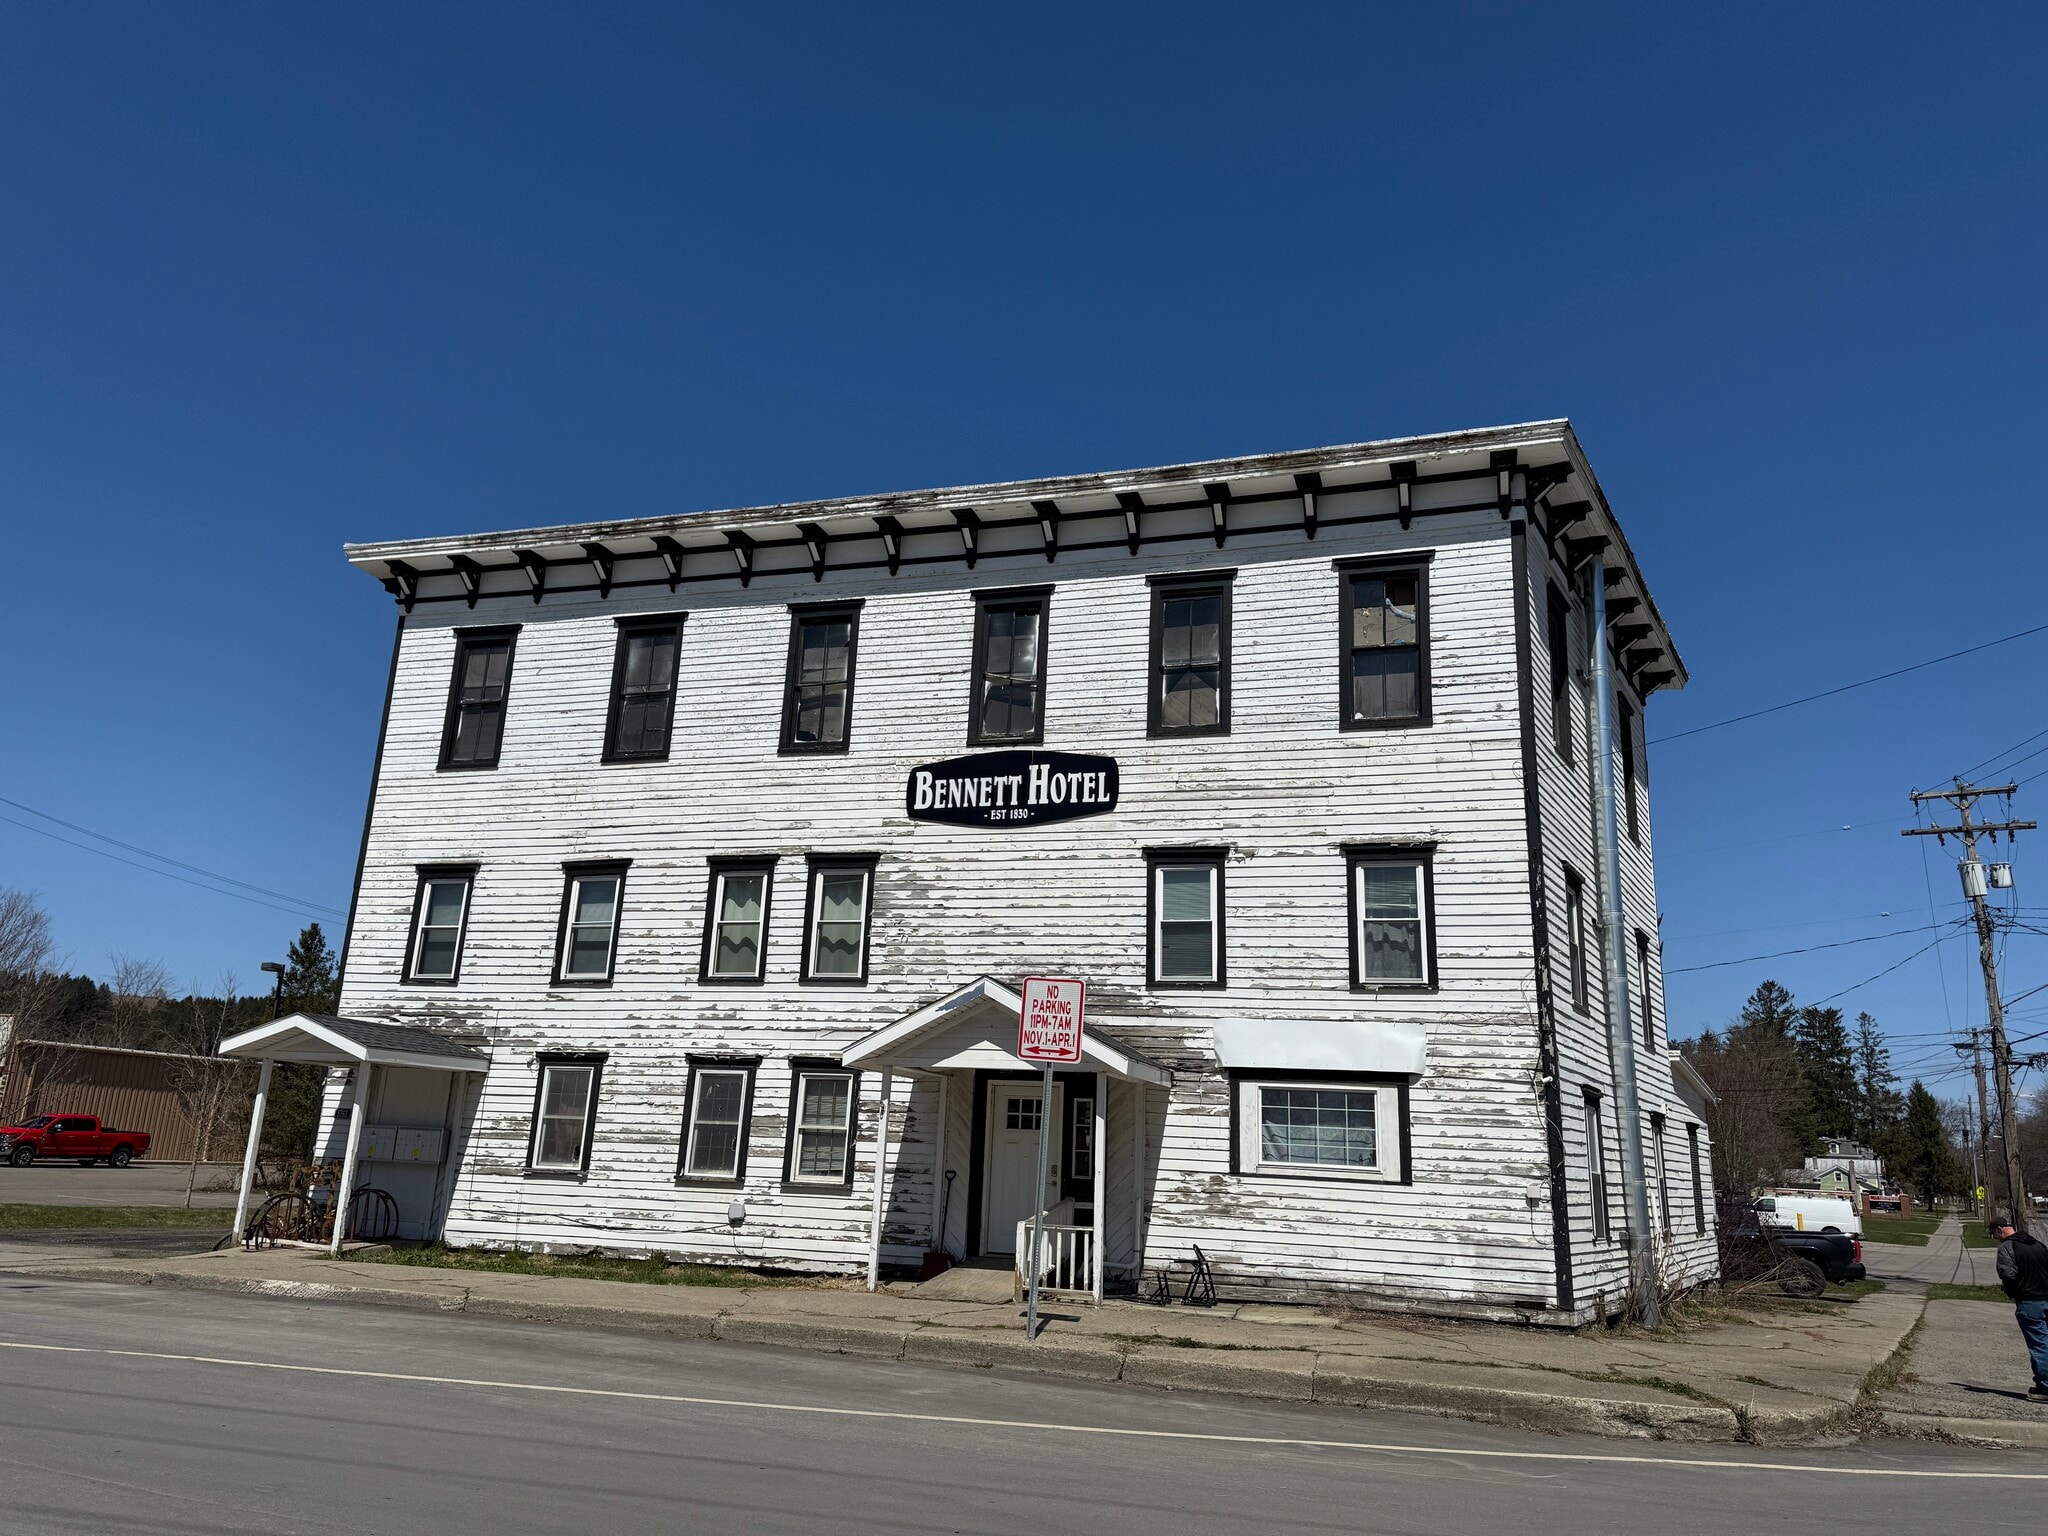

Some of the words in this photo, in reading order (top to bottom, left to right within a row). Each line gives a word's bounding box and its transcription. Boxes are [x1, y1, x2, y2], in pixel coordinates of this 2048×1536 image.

[913, 770, 1023, 810] BENNETT
[1027, 764, 1111, 805] HOTEL
[990, 809, 1007, 820] EST
[1046, 985, 1059, 999] NO
[1032, 999, 1071, 1015] PARKING
[1030, 1014, 1072, 1030] 11PM-7AM
